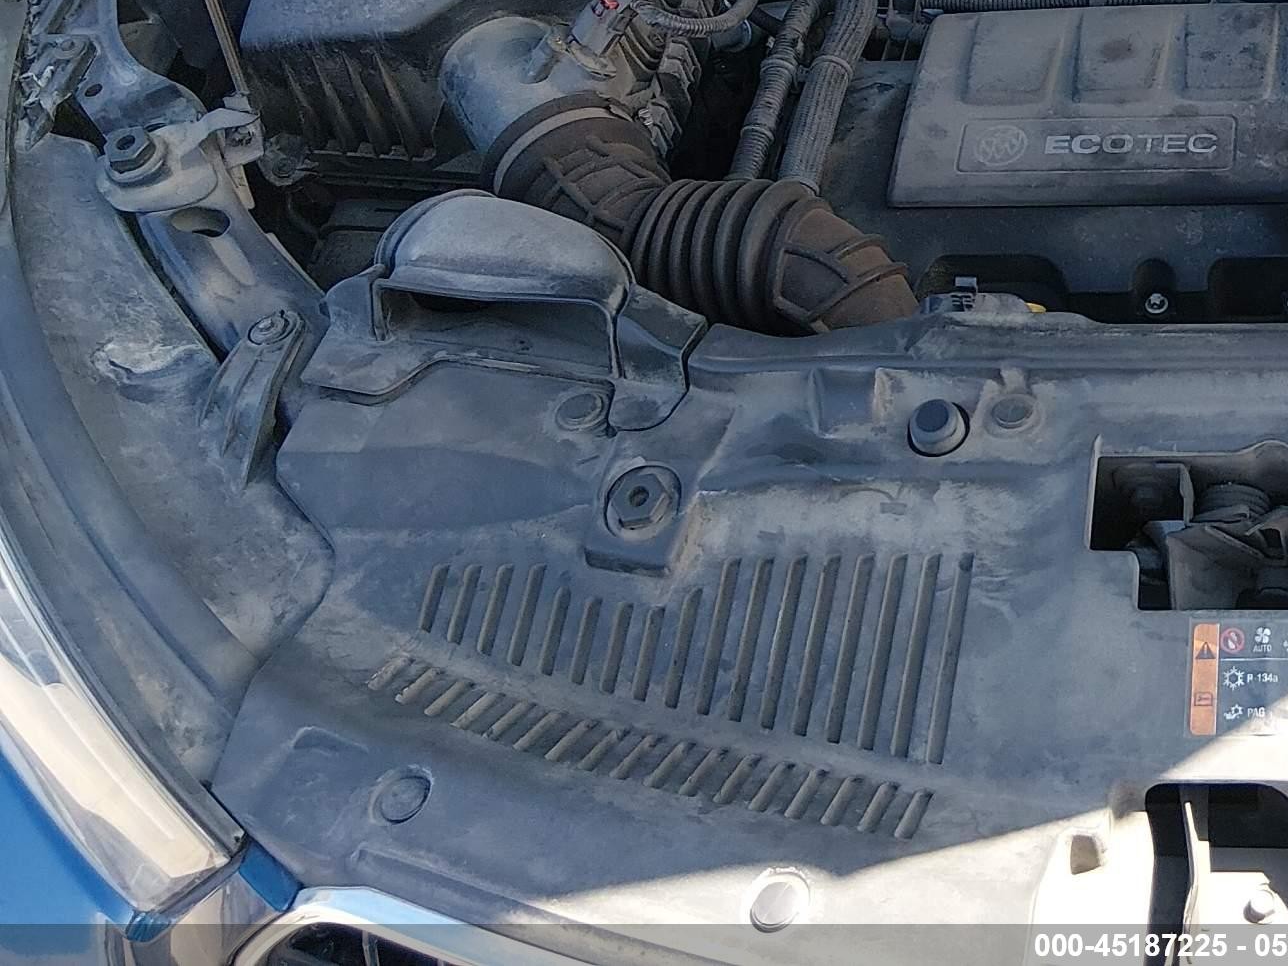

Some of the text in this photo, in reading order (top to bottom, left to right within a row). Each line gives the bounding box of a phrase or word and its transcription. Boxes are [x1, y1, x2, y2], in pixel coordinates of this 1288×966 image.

[1044, 133, 1218, 155] ECOTEC
[1253, 644, 1272, 652] AUTO
[1247, 707, 1265, 718] PAG
